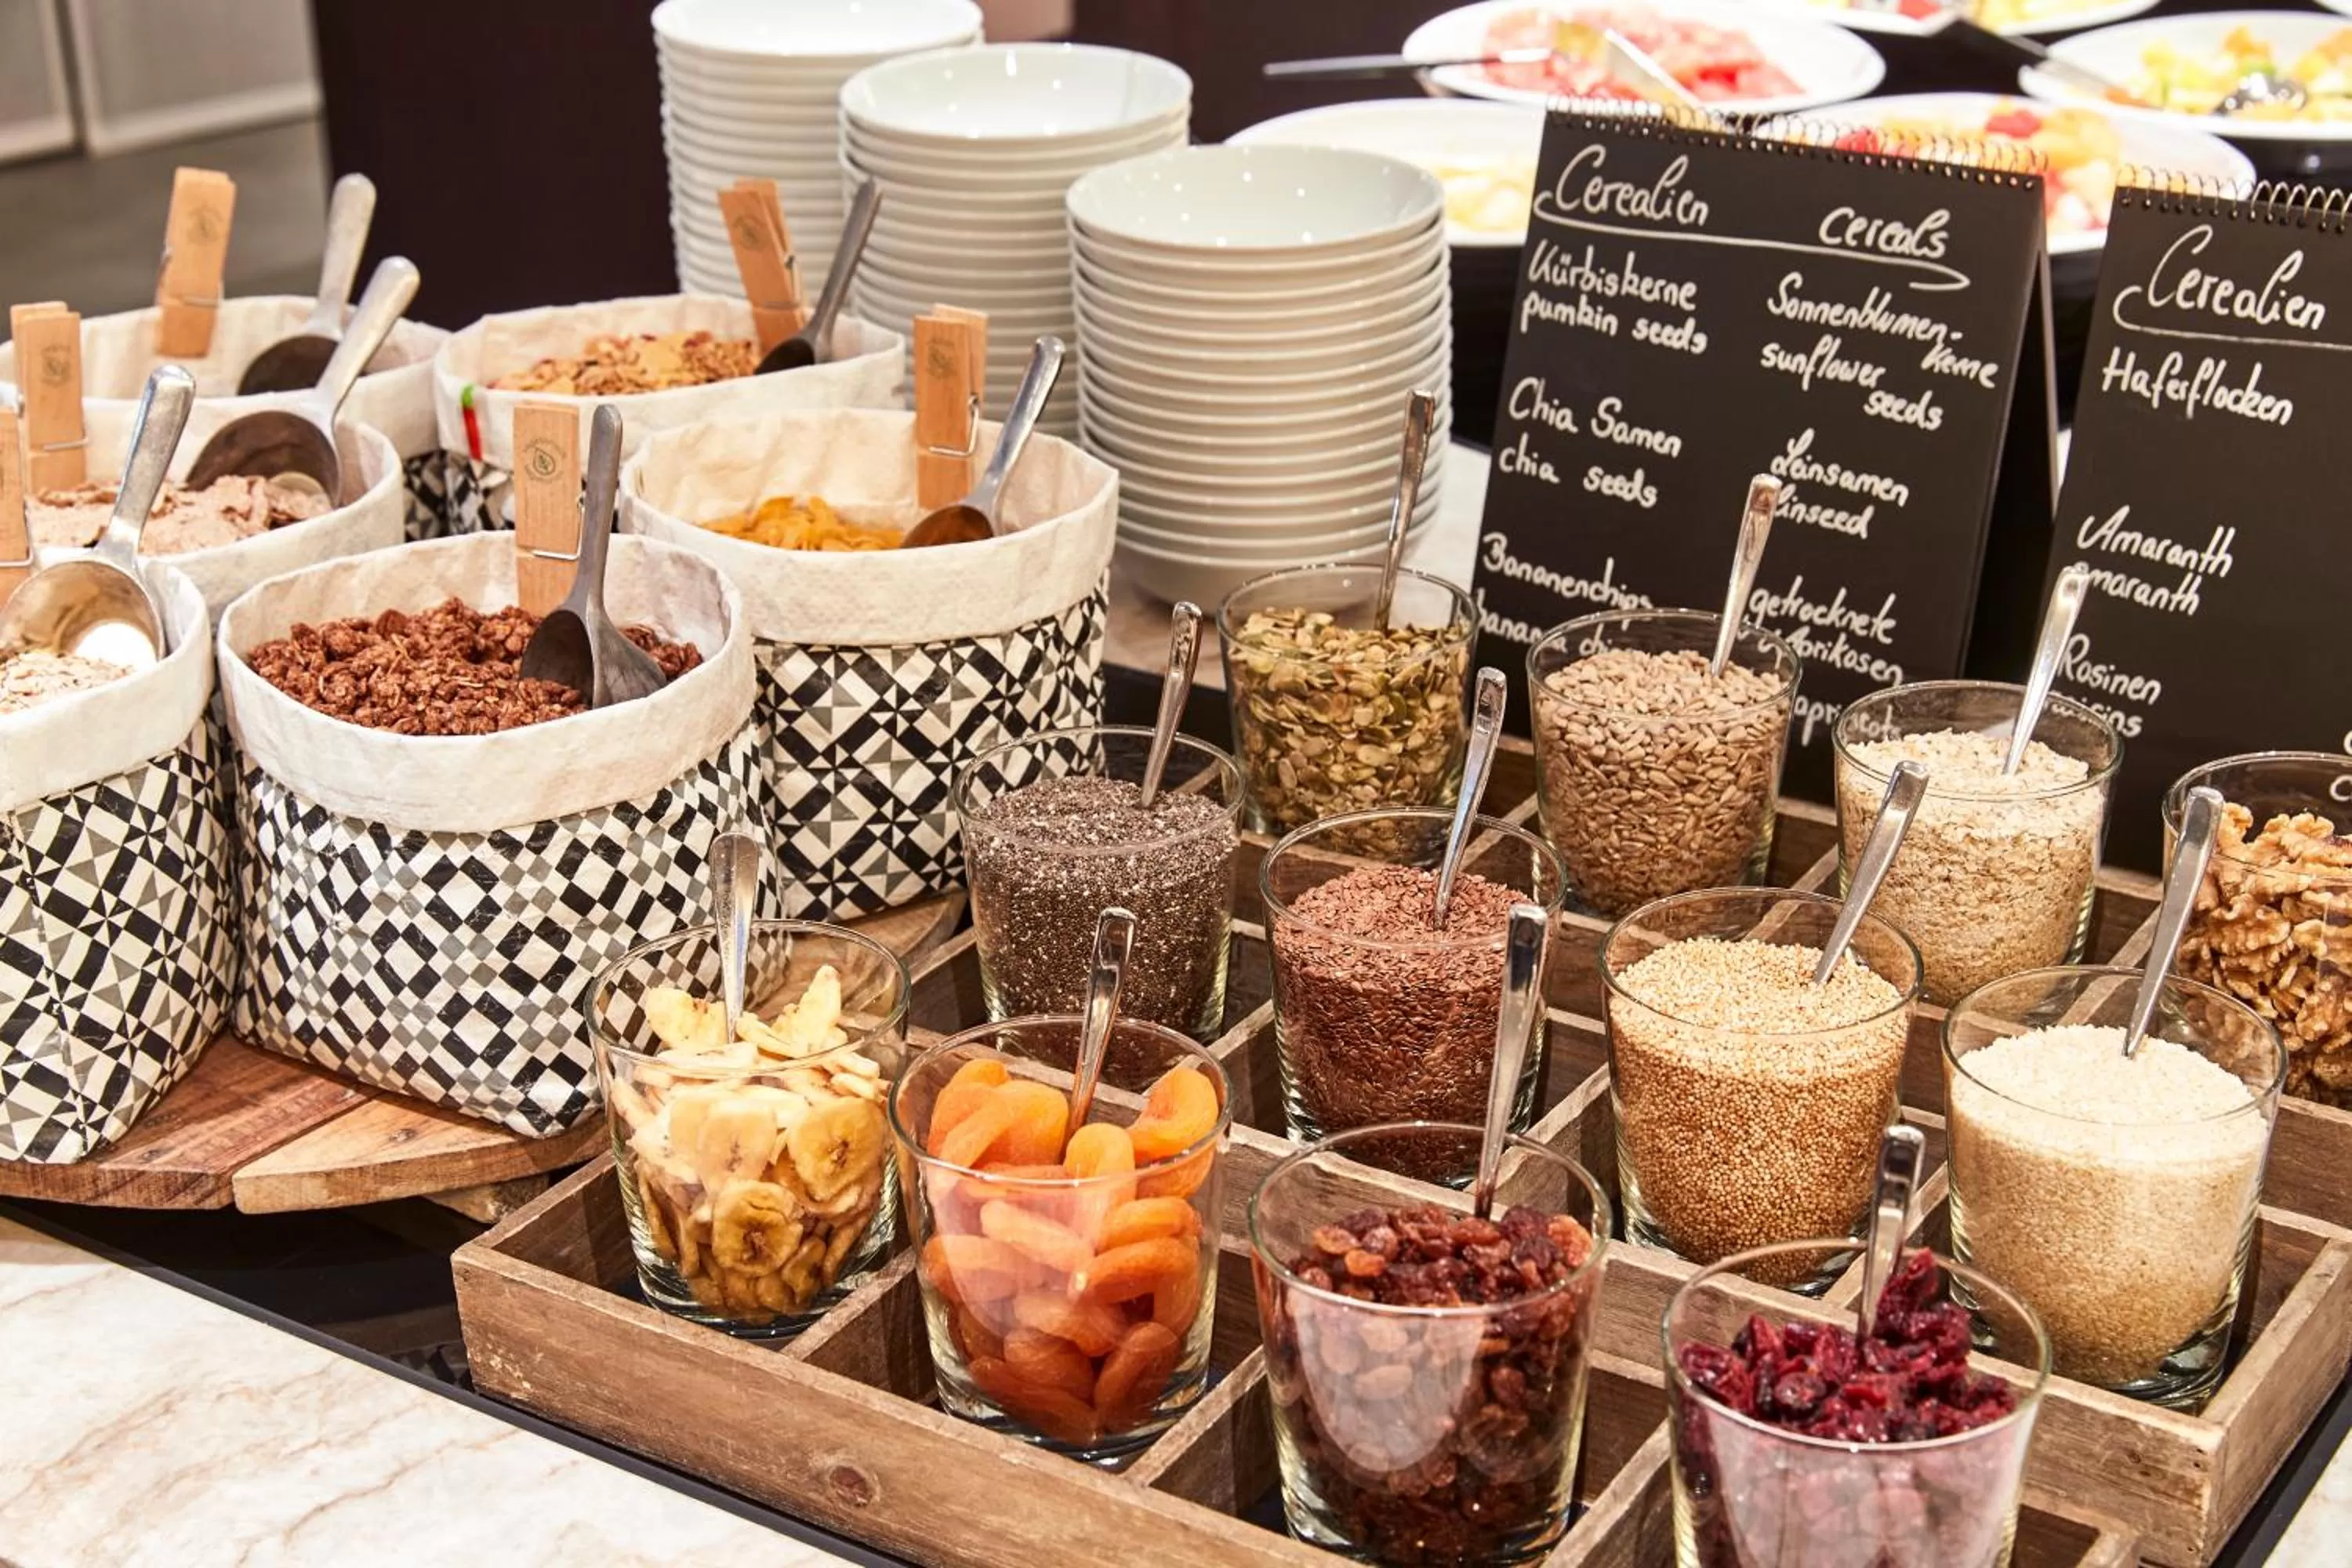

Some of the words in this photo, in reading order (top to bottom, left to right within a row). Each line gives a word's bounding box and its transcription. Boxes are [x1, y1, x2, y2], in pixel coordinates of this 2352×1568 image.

[1555, 144, 1708, 227] Cerealien
[1529, 238, 1697, 310] Kürbiskerne
[1767, 271, 1962, 343] Sonnenblumen-
[2148, 224, 2325, 330] Cerealien
[1632, 316, 1708, 354] seeds
[1760, 334, 1886, 391] sunflower
[1508, 376, 1579, 434] Chia
[1591, 397, 1682, 459] Samen
[1863, 390, 1944, 430] seeds
[2102, 346, 2293, 426] Haferflocken
[1499, 432, 1561, 484] chia
[1583, 466, 1657, 508] seeds
[1770, 427, 1909, 507] Leinsamen
[2077, 504, 2236, 578] Amaranth
[1483, 531, 1653, 631] Bananenchips
[1749, 575, 1897, 644] getrocknete
[2057, 633, 2161, 705] Rosinen
